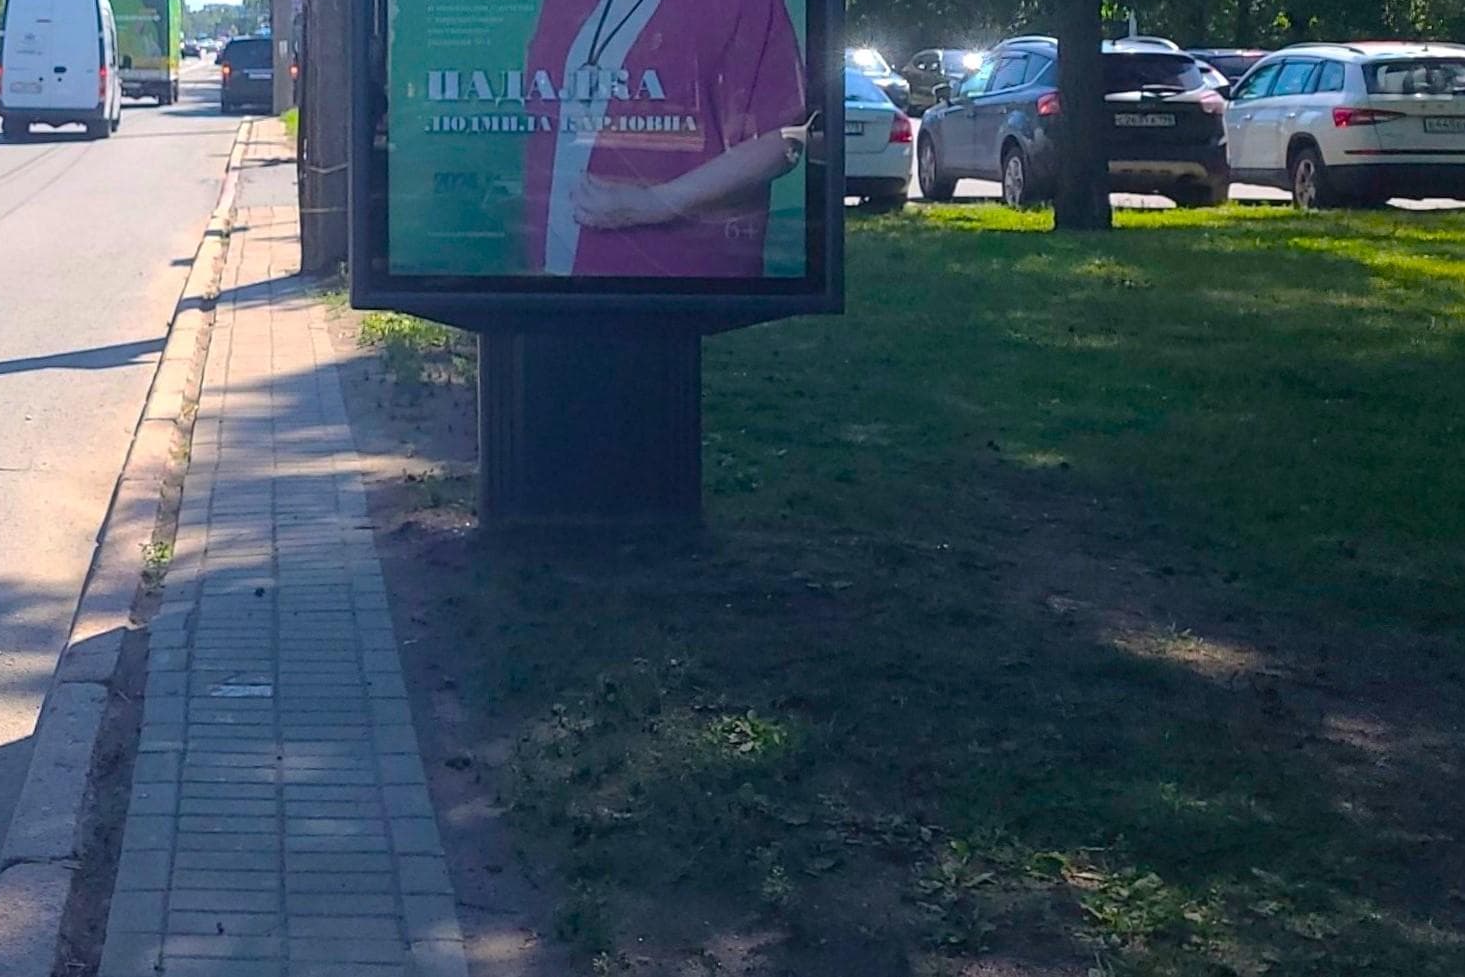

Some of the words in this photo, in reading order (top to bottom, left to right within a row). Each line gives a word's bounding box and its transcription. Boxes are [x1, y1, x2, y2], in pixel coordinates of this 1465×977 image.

[427, 68, 667, 107] ПАДАЛКА
[424, 115, 551, 135] ЛЮДМИЛА
[562, 115, 697, 132] КАРЛОВНА
